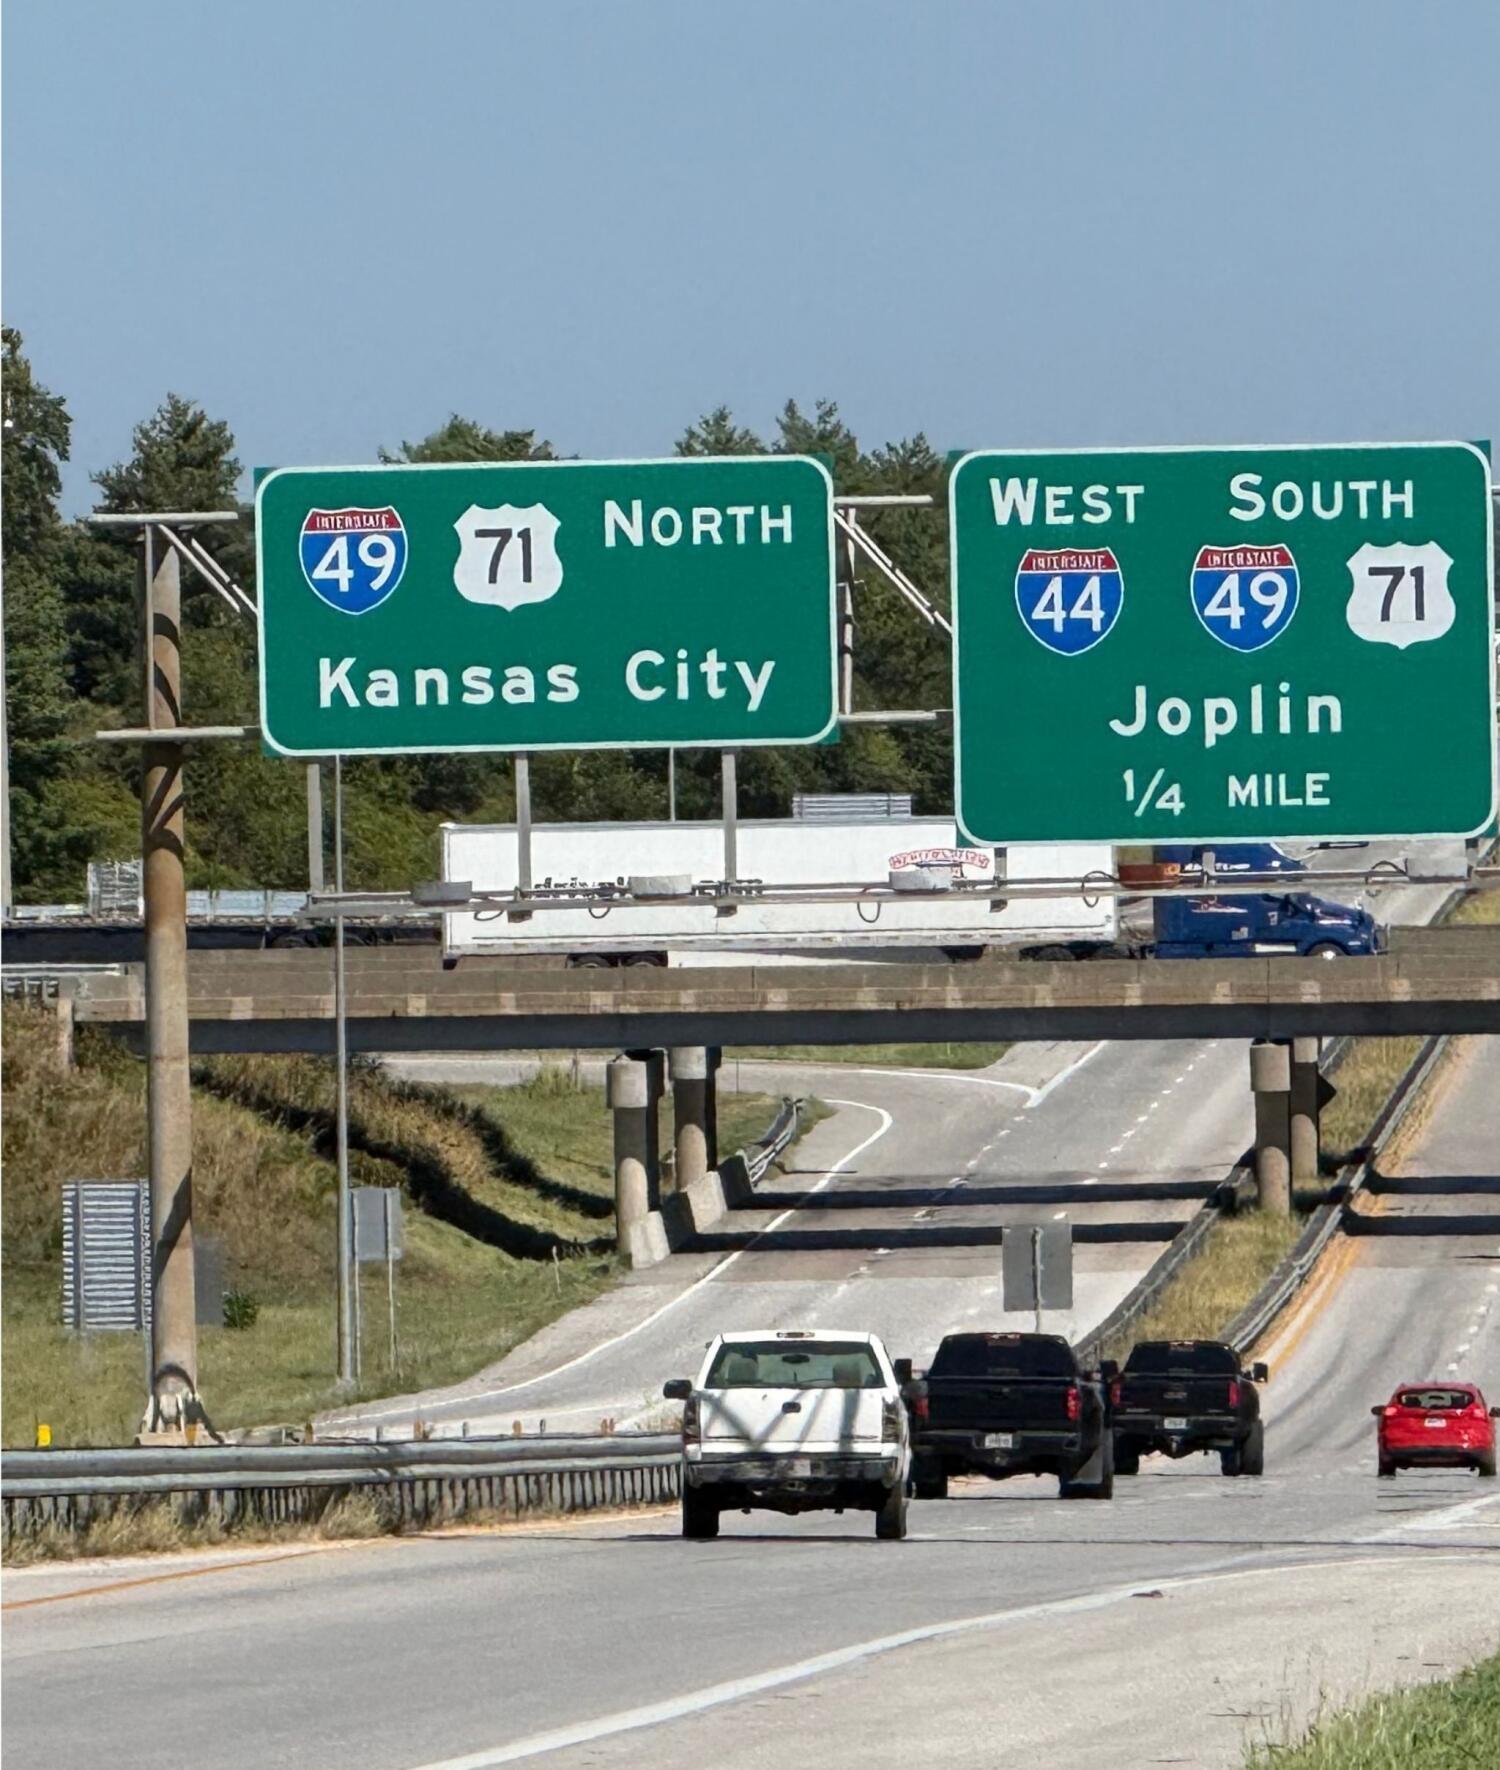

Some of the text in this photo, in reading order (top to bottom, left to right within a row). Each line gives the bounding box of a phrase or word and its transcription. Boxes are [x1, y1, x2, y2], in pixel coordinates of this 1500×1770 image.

[604, 499, 792, 547] NORTH
[990, 473, 1413, 525] WEST SOUTH
[311, 533, 397, 593] 49
[475, 527, 532, 585] 71
[1031, 565, 1425, 633] 44 49 71
[319, 648, 776, 712] Kansas City
[1109, 682, 1342, 748] Joplin
[1123, 768, 1330, 817] 1/4 MILE
